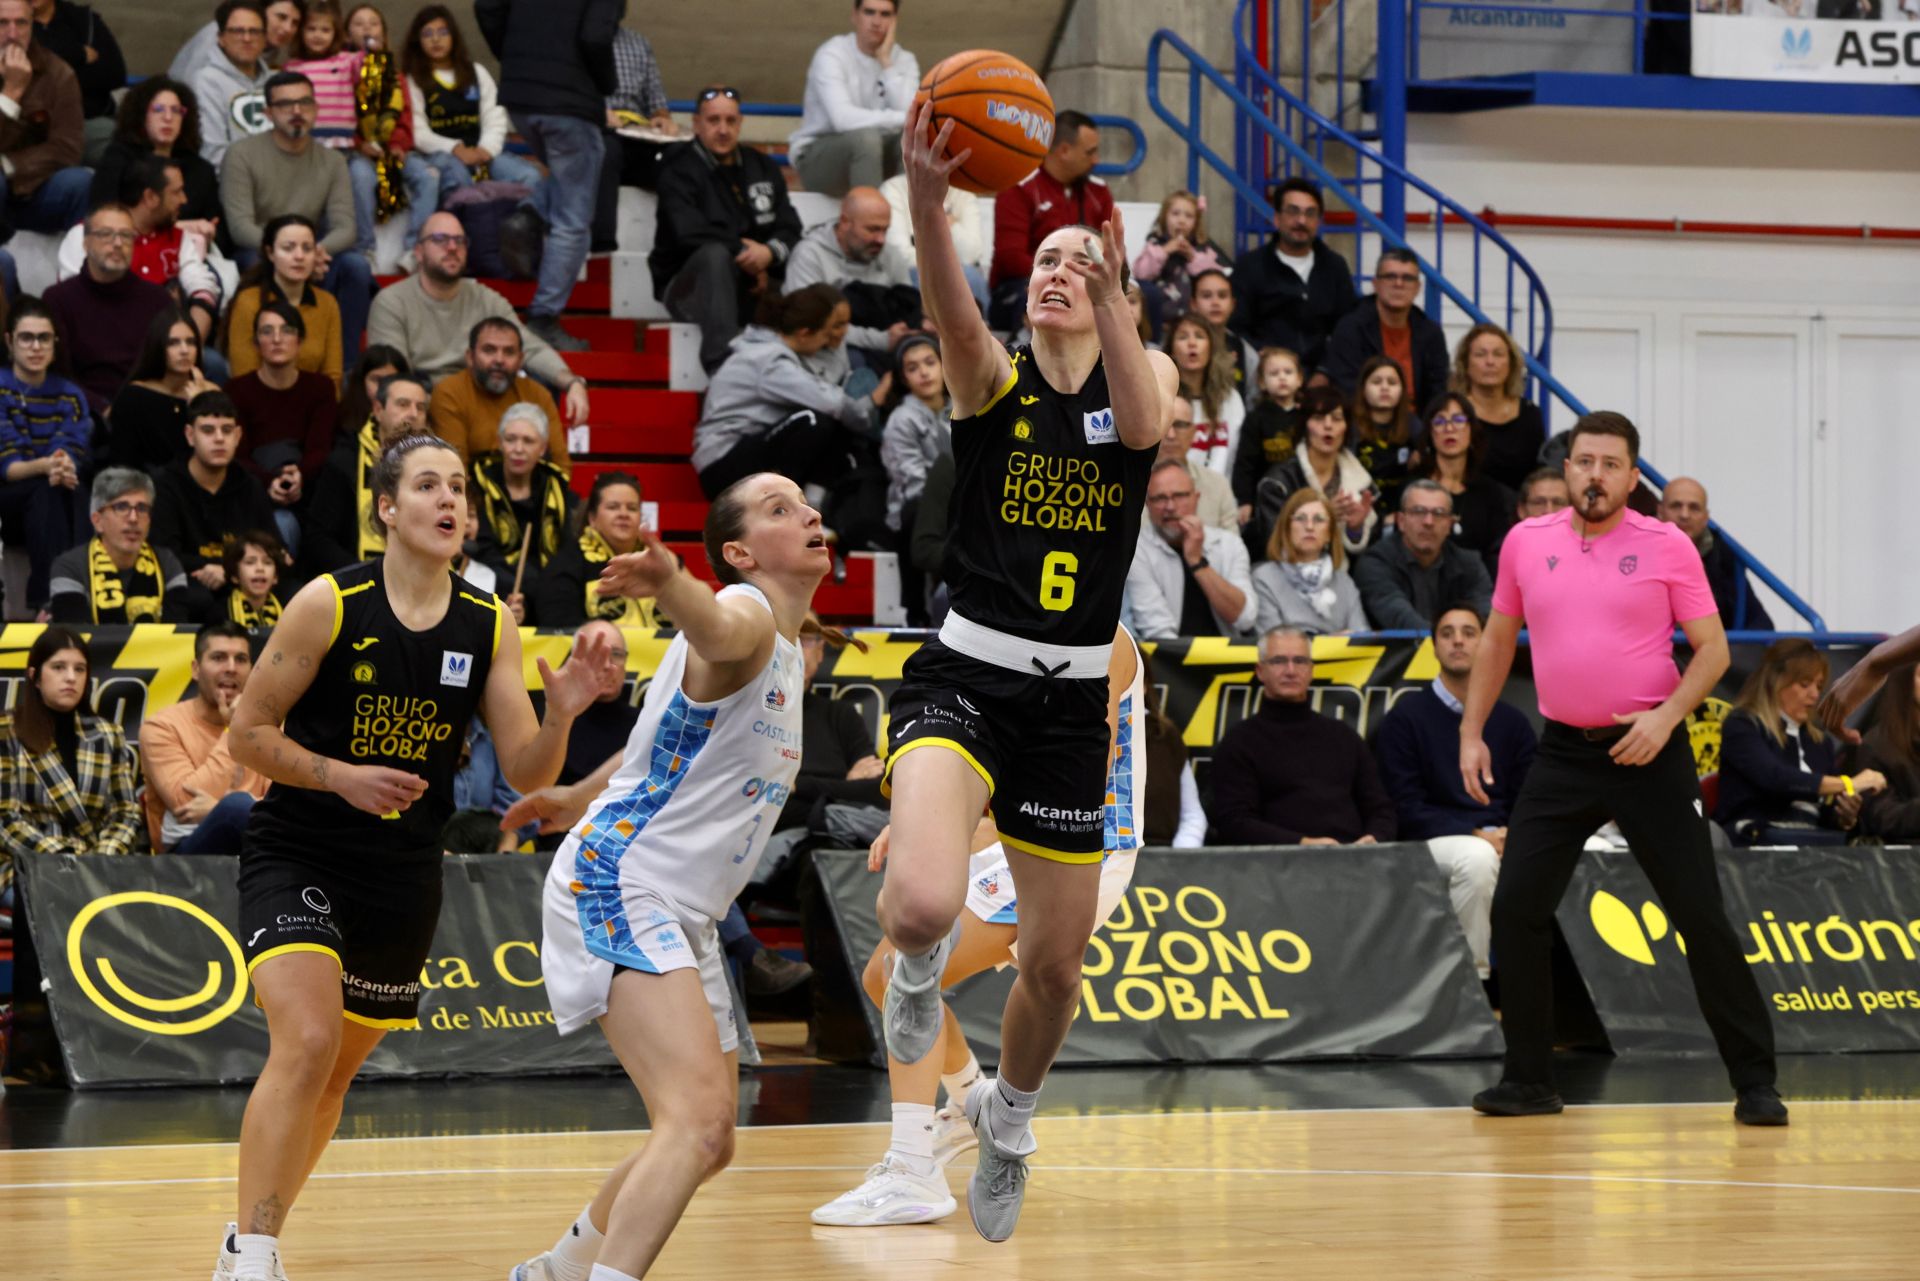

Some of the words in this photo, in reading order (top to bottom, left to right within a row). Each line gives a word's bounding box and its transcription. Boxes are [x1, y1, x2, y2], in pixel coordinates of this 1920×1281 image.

[1008, 451, 1100, 484] GRUPO
[1003, 475, 1124, 508] HOZONO
[1000, 500, 1107, 532] GLOBAL
[1039, 550, 1079, 612] 6
[341, 970, 420, 995] Alcantarill
[1772, 985, 1853, 1012] salud
[1072, 976, 1290, 1022] LOBAL
[431, 1006, 471, 1031] de
